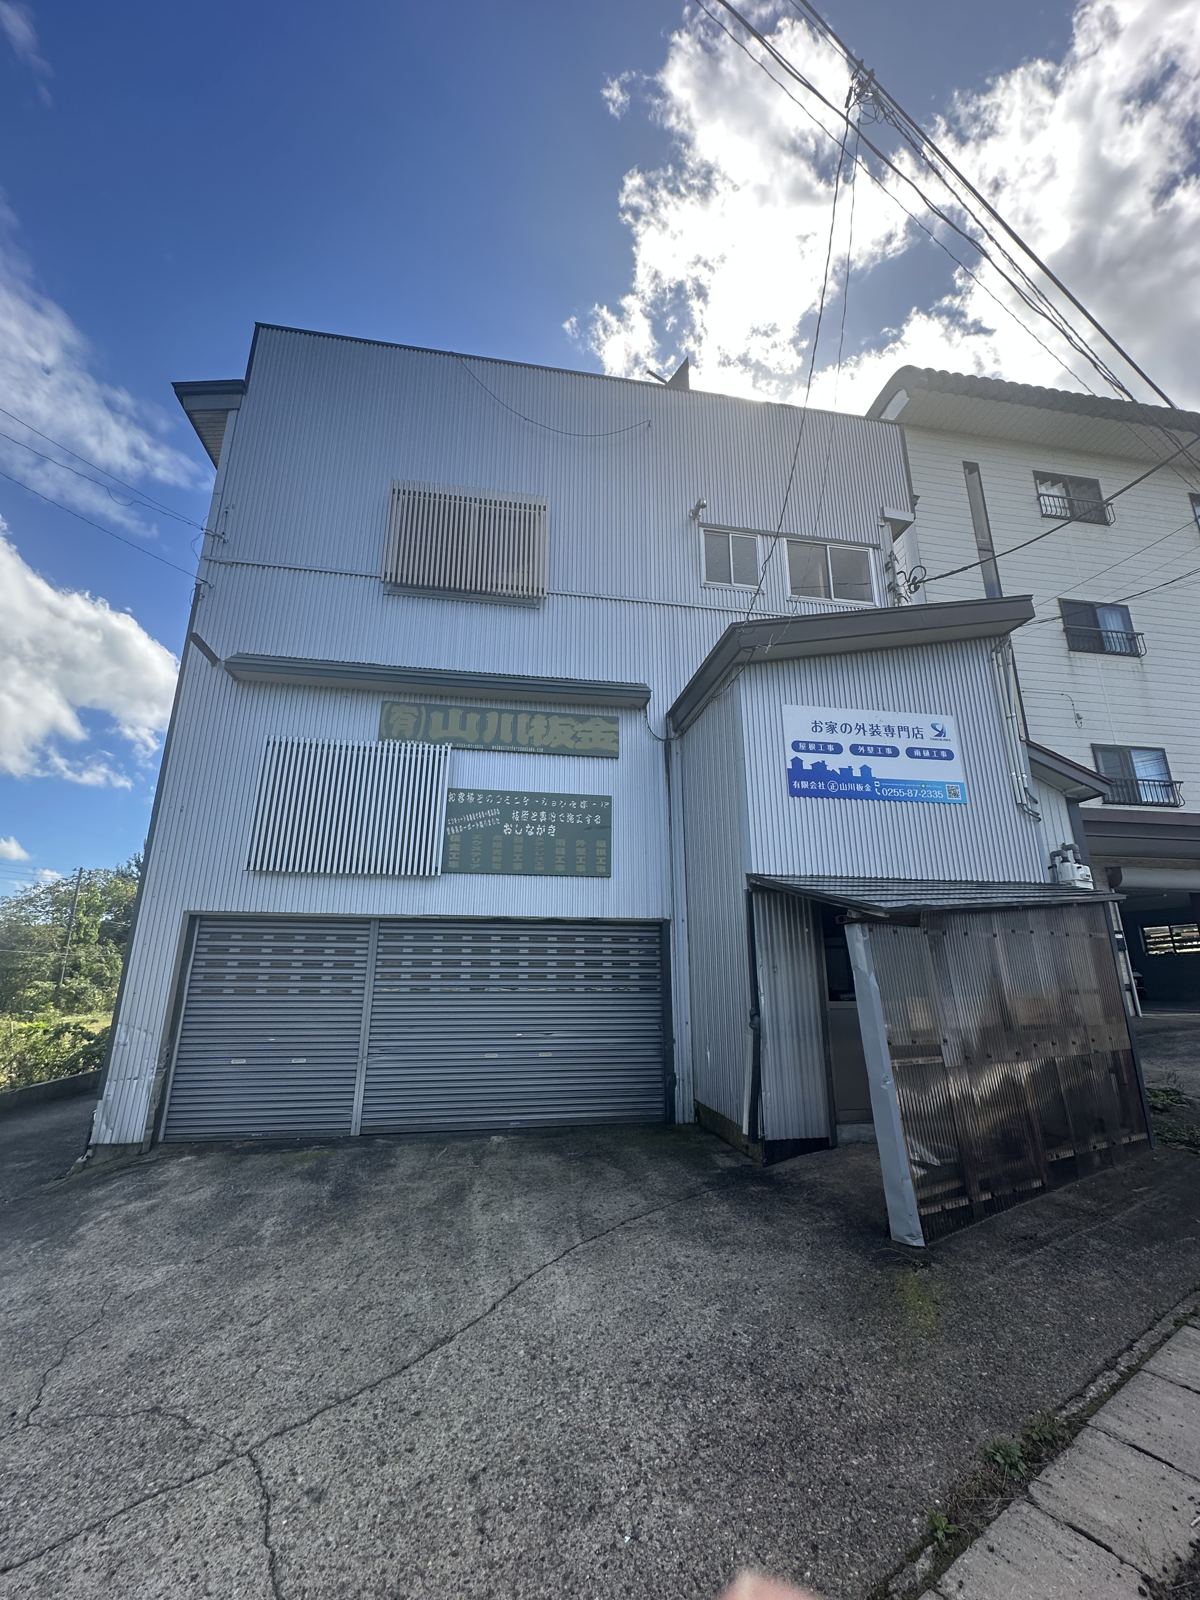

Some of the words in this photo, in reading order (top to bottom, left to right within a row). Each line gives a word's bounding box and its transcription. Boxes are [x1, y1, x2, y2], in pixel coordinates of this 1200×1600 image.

[811, 720, 924, 740] お家の外装専門店
[799, 742, 835, 752] 屋根工事
[857, 745, 893, 755] 外壁工事
[881, 788, 944, 799] 0255-87-2335
[503, 823, 556, 837] おしながき
